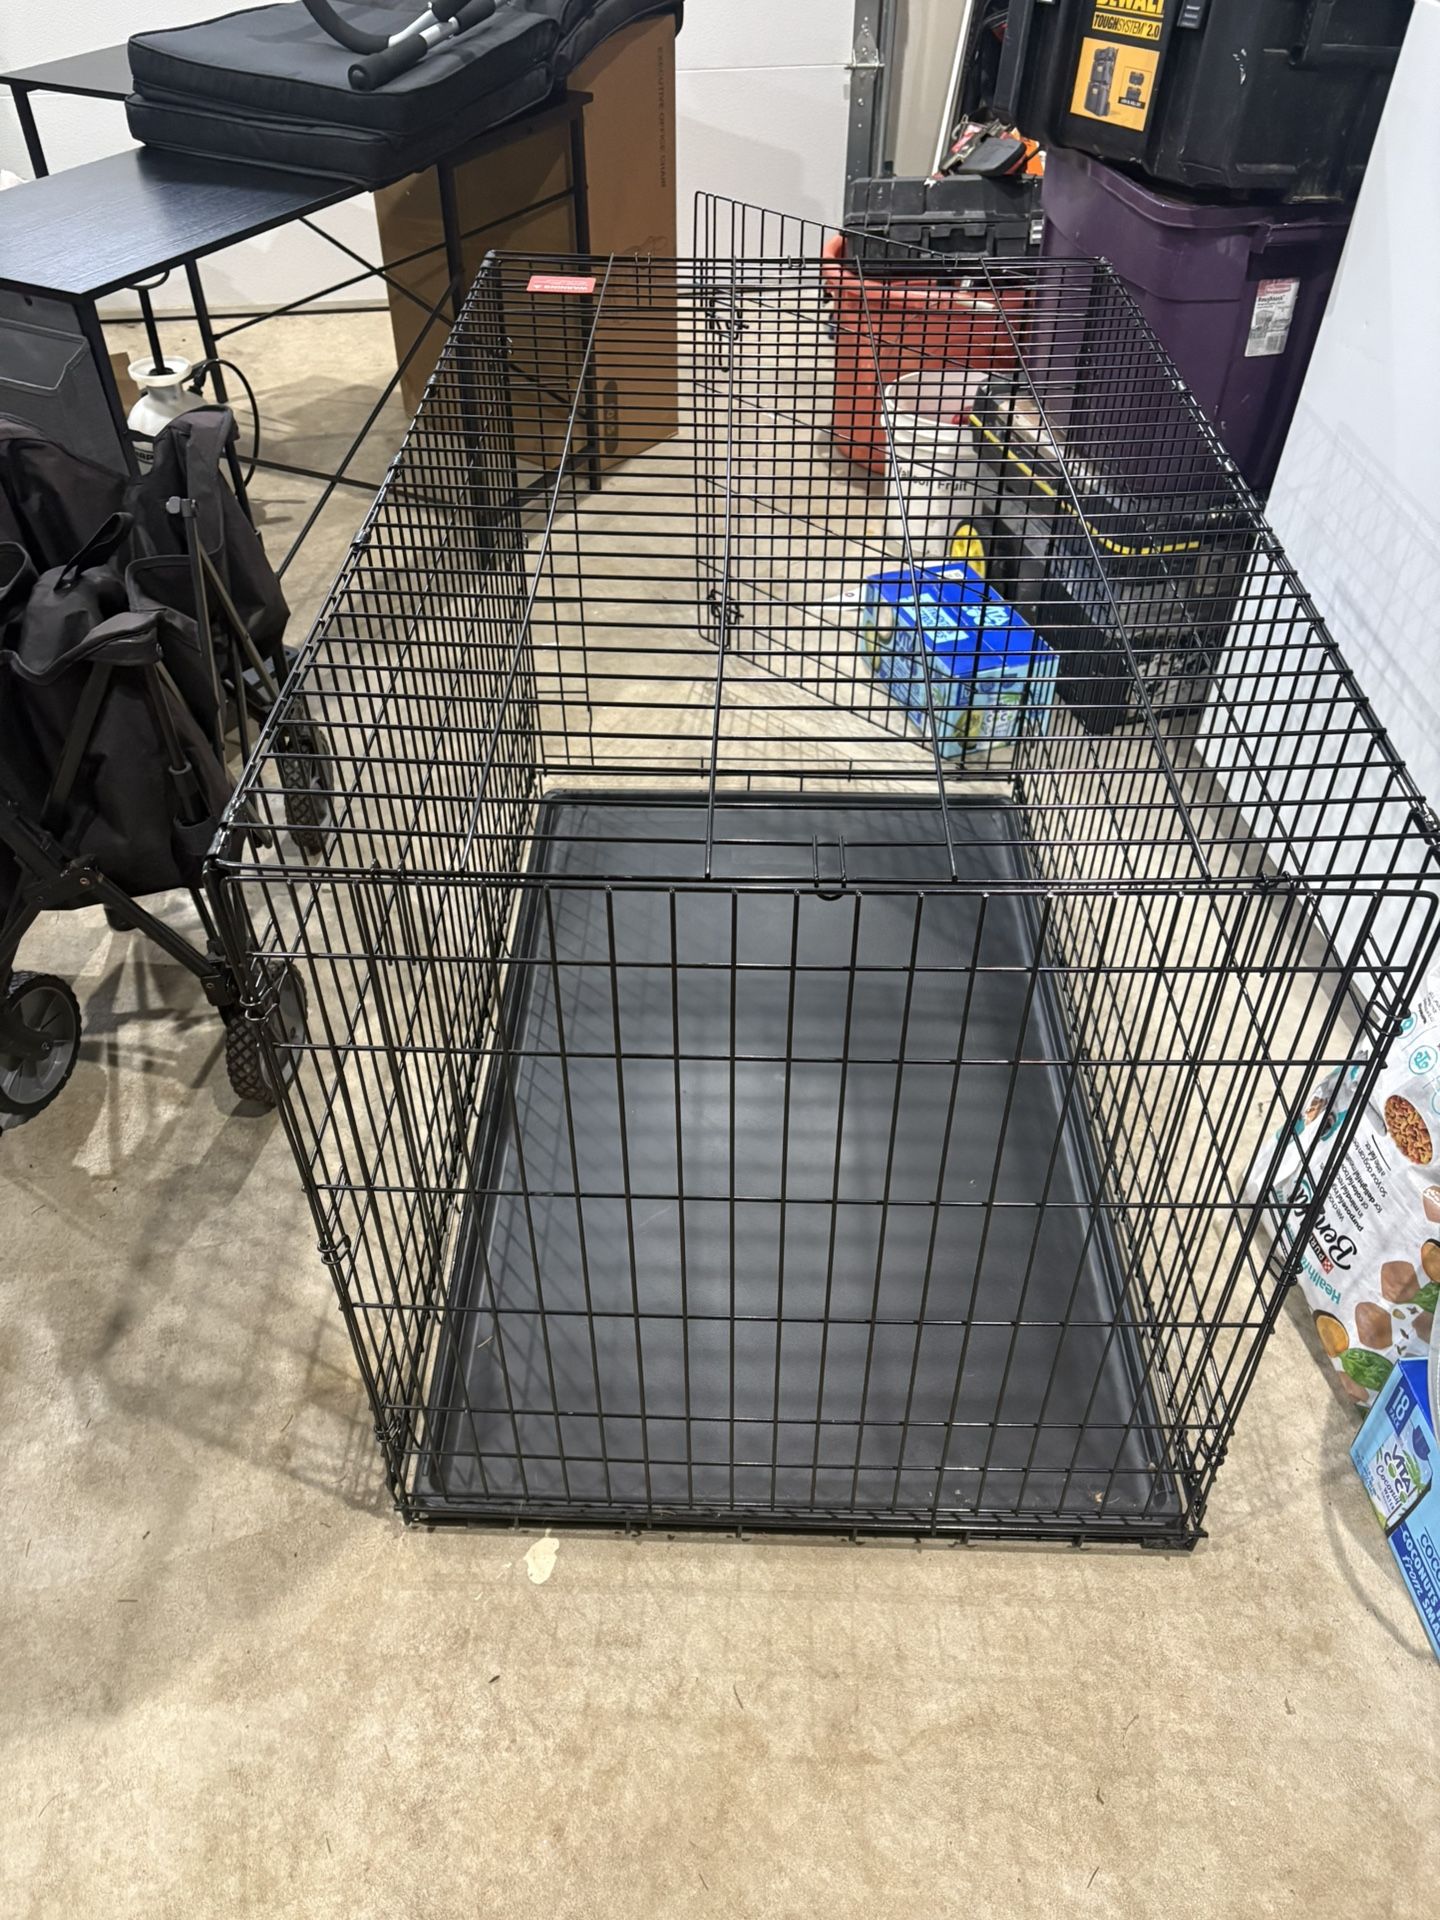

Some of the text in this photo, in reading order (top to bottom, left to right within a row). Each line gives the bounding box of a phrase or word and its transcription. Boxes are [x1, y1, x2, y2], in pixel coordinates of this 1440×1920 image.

[1146, 24, 1160, 38] 2.0
[1362, 1158, 1373, 1173] dog
[1370, 1172, 1382, 1188] your
[1340, 1184, 1360, 1212] mindful
[1345, 1175, 1364, 1202] colorful
[1352, 1170, 1376, 1203] delightful
[1335, 1193, 1364, 1232] purposeful
[1388, 1407, 1400, 1429] PACK
[1391, 1386, 1410, 1421] 18
[1384, 1451, 1408, 1503] COCO
[1392, 1443, 1411, 1493] VITA
[1402, 1530, 1438, 1607] COCONUTS
[1402, 1555, 1440, 1645] from SMA
